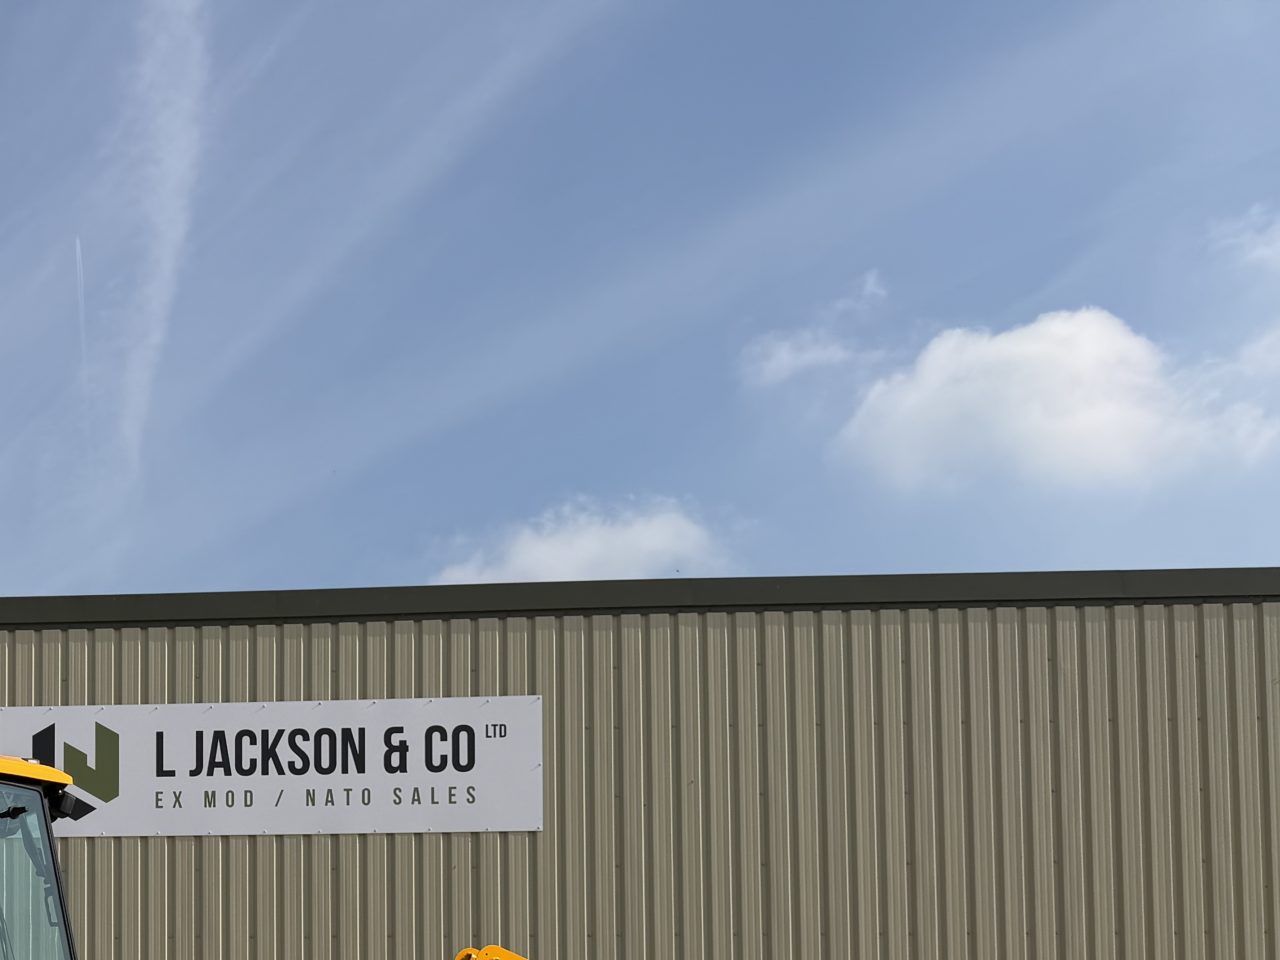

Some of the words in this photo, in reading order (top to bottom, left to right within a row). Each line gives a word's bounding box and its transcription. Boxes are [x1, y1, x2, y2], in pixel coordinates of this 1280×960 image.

[155, 731, 176, 778] L
[189, 727, 366, 777] JACKSON
[383, 726, 410, 775] &
[424, 724, 476, 773] CO
[485, 723, 507, 739] LTD
[155, 790, 183, 809] EX
[203, 789, 254, 808] MOD
[275, 789, 284, 808] /
[305, 787, 372, 807] NATO
[392, 785, 477, 806] SALES
